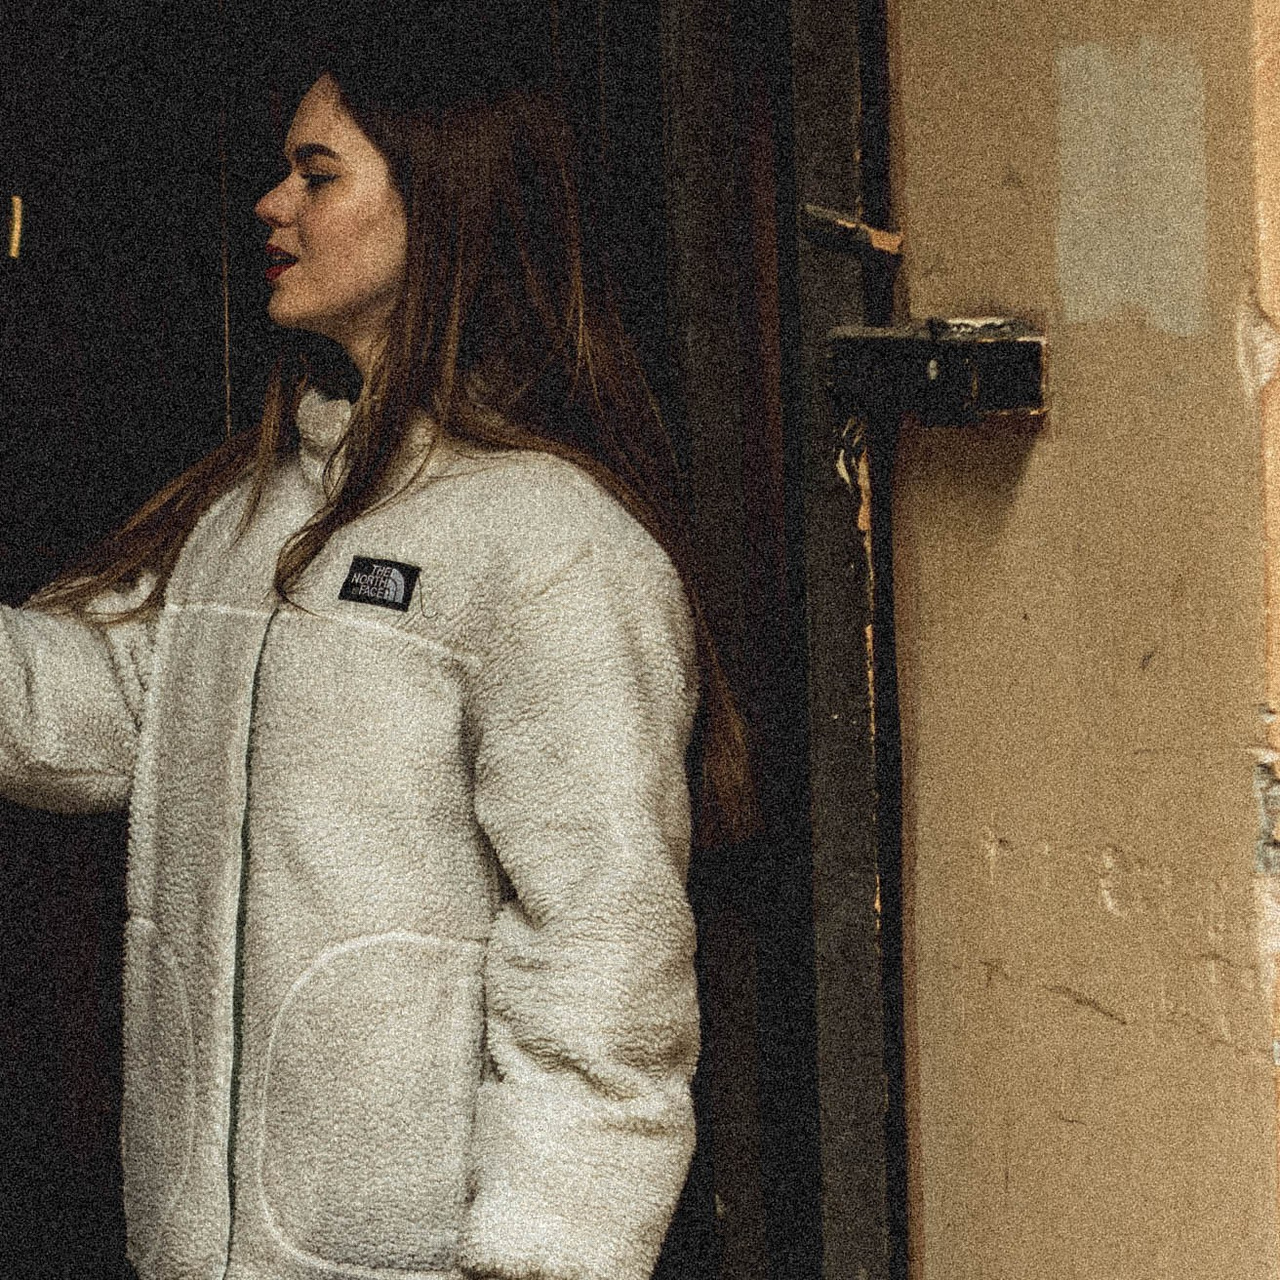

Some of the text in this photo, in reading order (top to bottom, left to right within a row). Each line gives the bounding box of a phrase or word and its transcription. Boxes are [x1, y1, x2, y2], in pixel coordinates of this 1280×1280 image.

[372, 564, 392, 578] THE
[351, 573, 389, 588] NORTH
[358, 585, 384, 598] FACE
